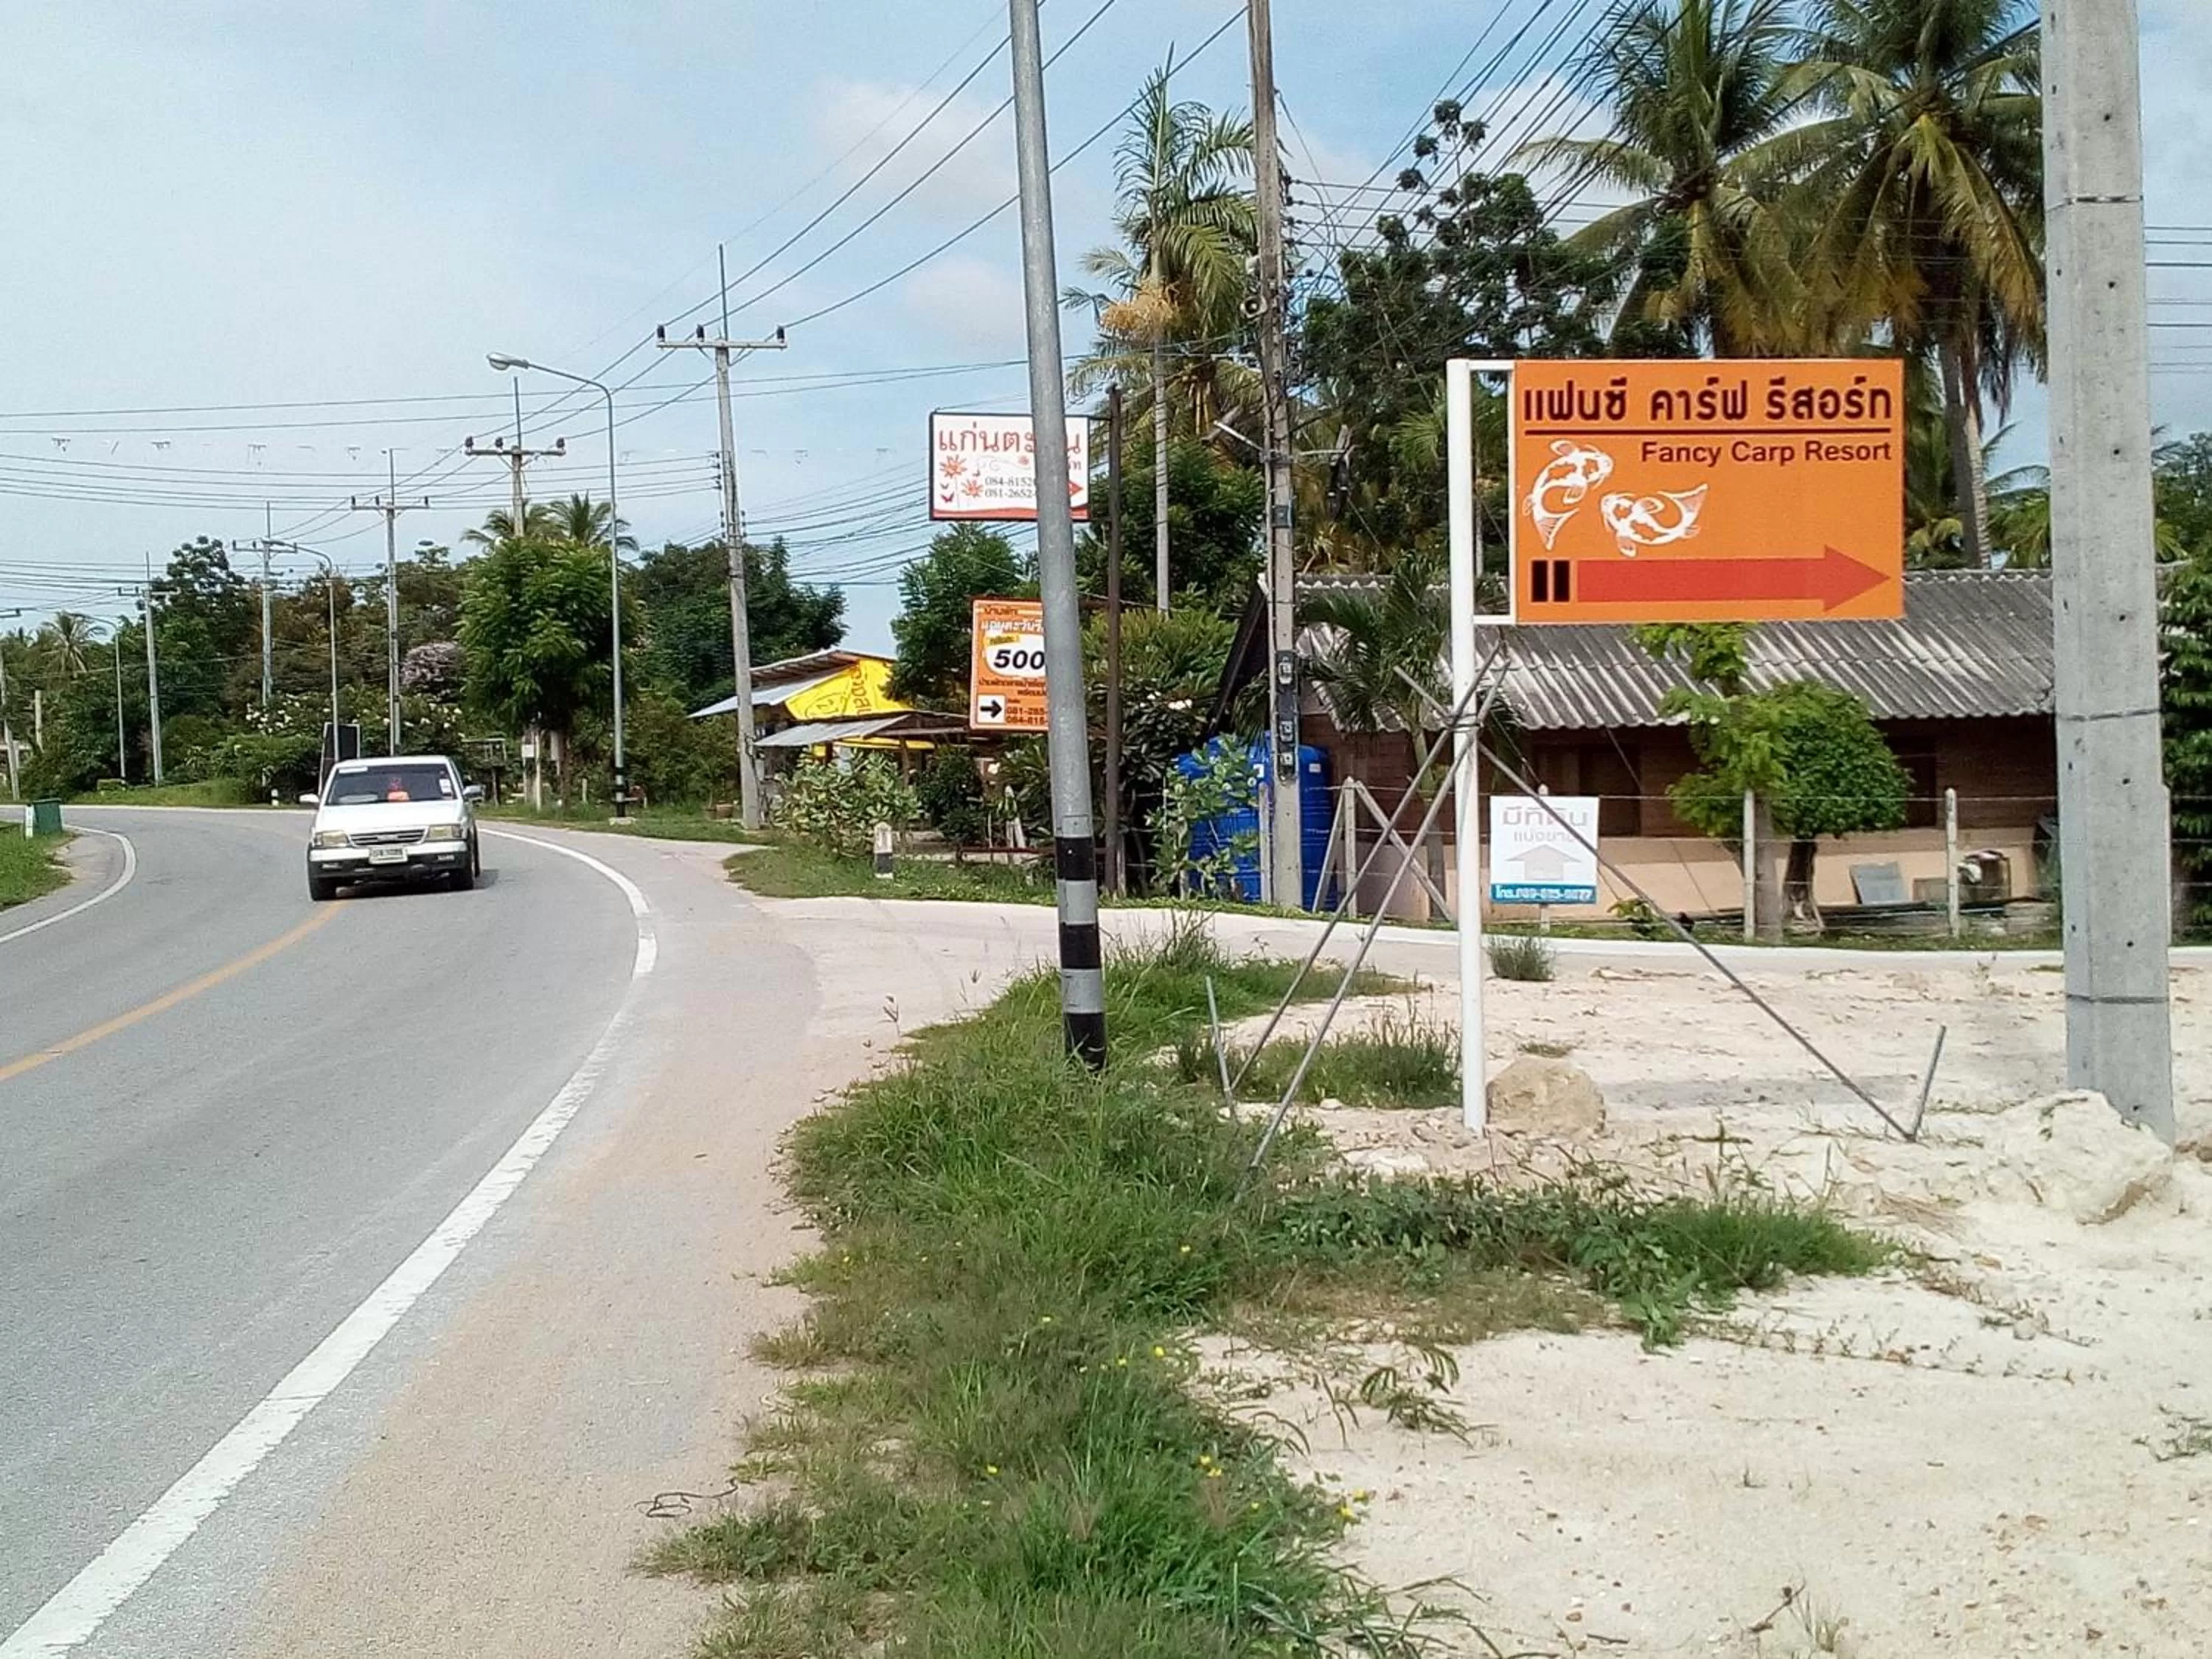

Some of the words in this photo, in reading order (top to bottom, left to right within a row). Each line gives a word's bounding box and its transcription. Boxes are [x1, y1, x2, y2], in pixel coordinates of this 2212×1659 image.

[1524, 376, 1627, 421] แฟนซี
[1650, 376, 1748, 421] คาร์ฟ
[1765, 375, 1892, 420] รีสอร์ท
[1641, 440, 1721, 467] Fancy
[1731, 440, 1795, 466] Carp
[1804, 440, 1891, 462] Resort
[993, 649, 1045, 670] 500
